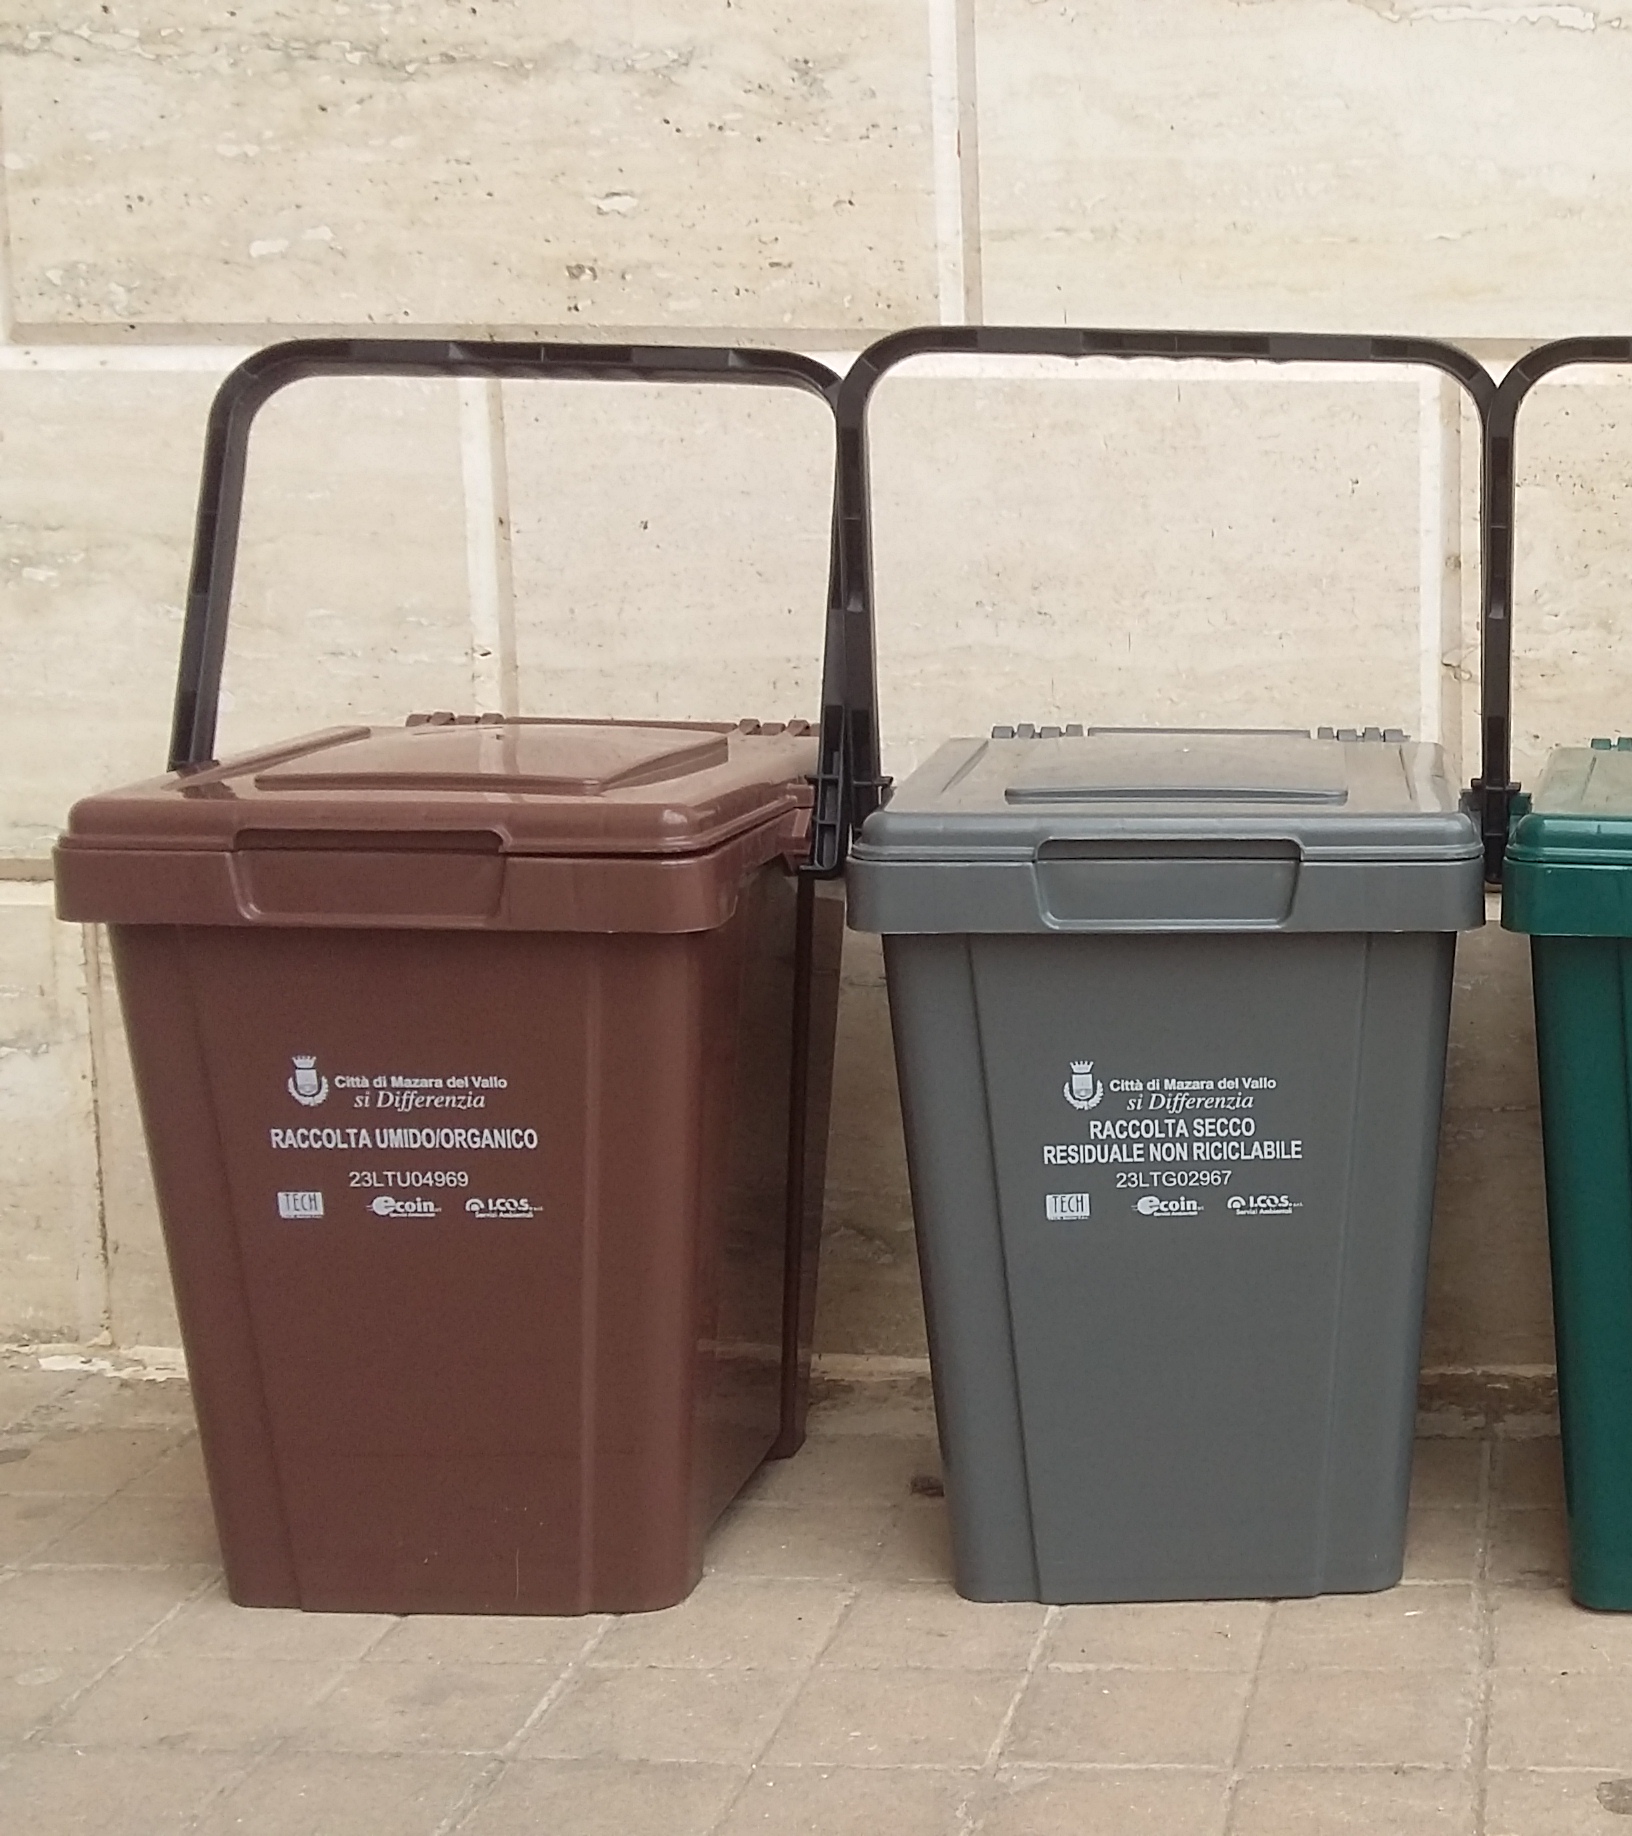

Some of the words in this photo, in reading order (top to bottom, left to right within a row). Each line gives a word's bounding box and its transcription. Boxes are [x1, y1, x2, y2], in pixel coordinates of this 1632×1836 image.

[334, 1075, 370, 1089] Città
[372, 1075, 388, 1088] di
[390, 1075, 444, 1089] Mazara
[446, 1075, 469, 1089] del
[470, 1075, 508, 1089] Vallo
[1109, 1078, 1144, 1092] Città
[1146, 1078, 1160, 1091] di
[1163, 1078, 1215, 1091] Mazara
[1217, 1077, 1239, 1090] del
[1241, 1076, 1277, 1090] Vallo
[353, 1090, 370, 1108] si
[376, 1090, 485, 1113] Differenzia
[1126, 1093, 1144, 1111] si
[1148, 1091, 1254, 1114] Differenzia
[1089, 1118, 1190, 1140] RACCOLTA
[1192, 1117, 1256, 1138] SECCO
[270, 1128, 373, 1149] RACCOLTA
[375, 1128, 538, 1149] UMIDO/ORGANICO
[1043, 1143, 1145, 1165] RESIDUALE
[1149, 1142, 1188, 1162] NON
[1192, 1140, 1303, 1161] RICICLABILE
[348, 1170, 469, 1188] 23LTU04969
[1115, 1170, 1232, 1188] 23LTG02967
[284, 1193, 318, 1211] TECH
[1052, 1196, 1084, 1212] TECH
